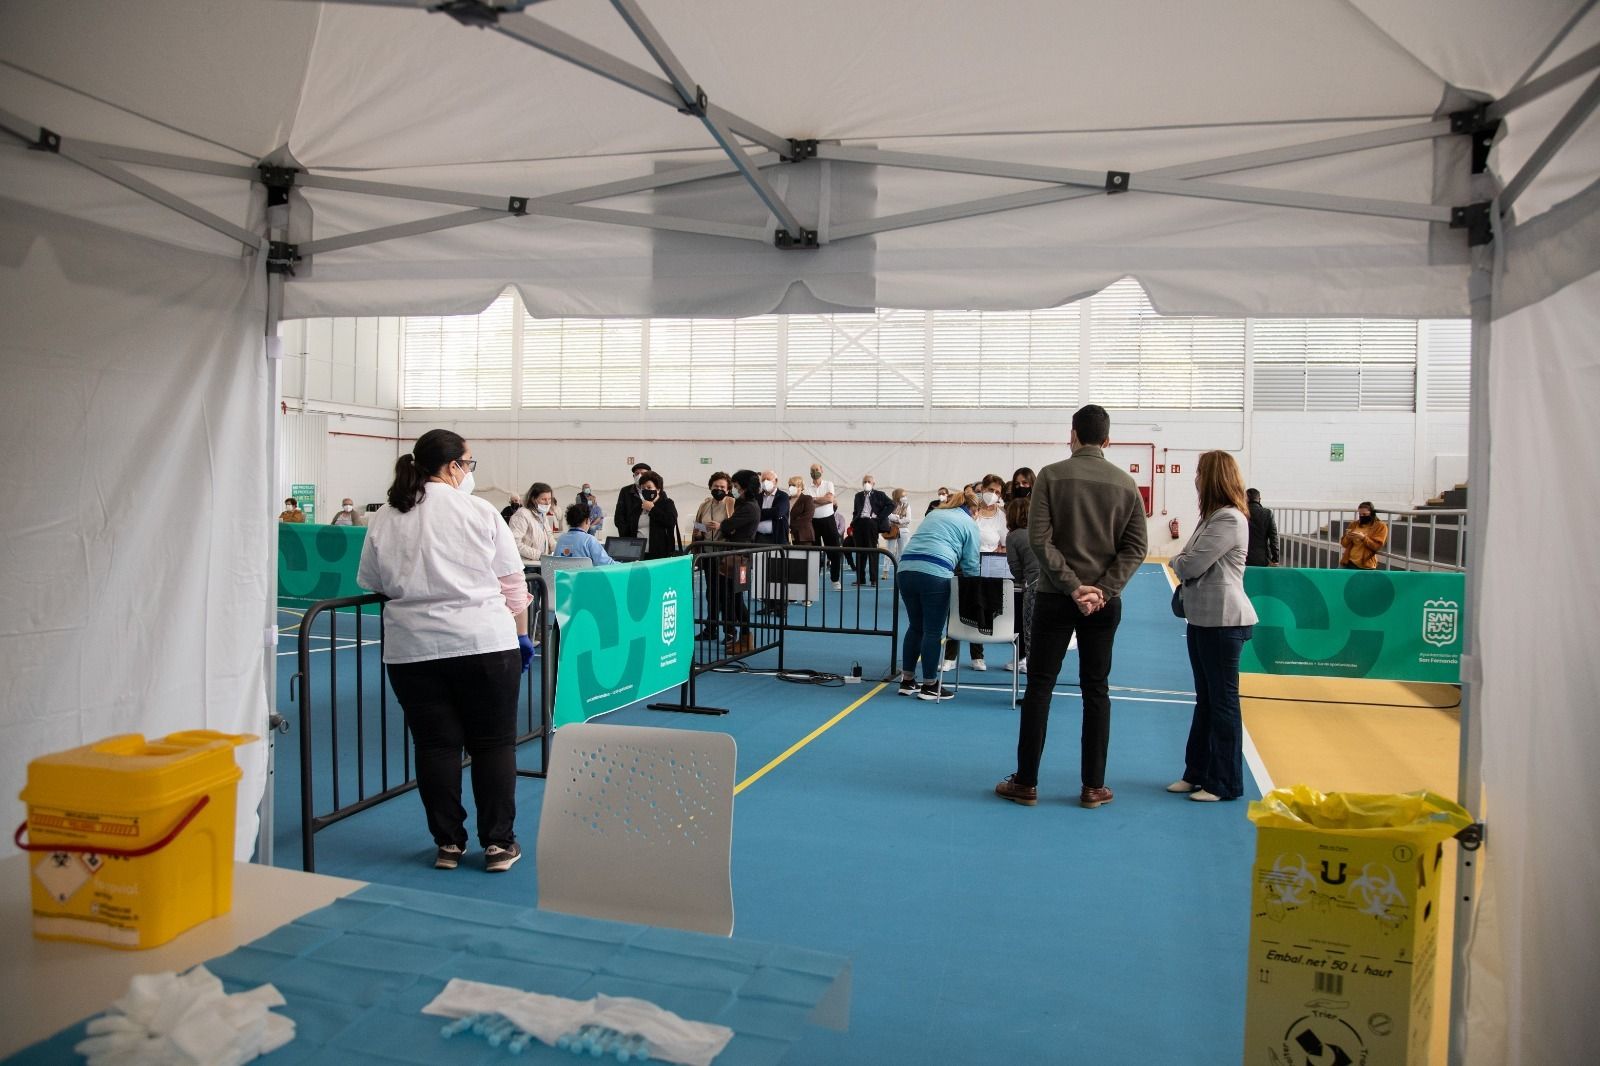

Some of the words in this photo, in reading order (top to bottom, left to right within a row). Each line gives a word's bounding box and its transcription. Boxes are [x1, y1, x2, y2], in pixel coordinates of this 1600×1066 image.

[1427, 612, 1453, 623] SAN
[1430, 657, 1458, 665] Fernando
[1266, 949, 1327, 968] Embal.net
[1330, 959, 1348, 972] 50
[1351, 964, 1360, 974] L
[1364, 966, 1393, 978] haut
[1311, 1010, 1338, 1019] Trier
